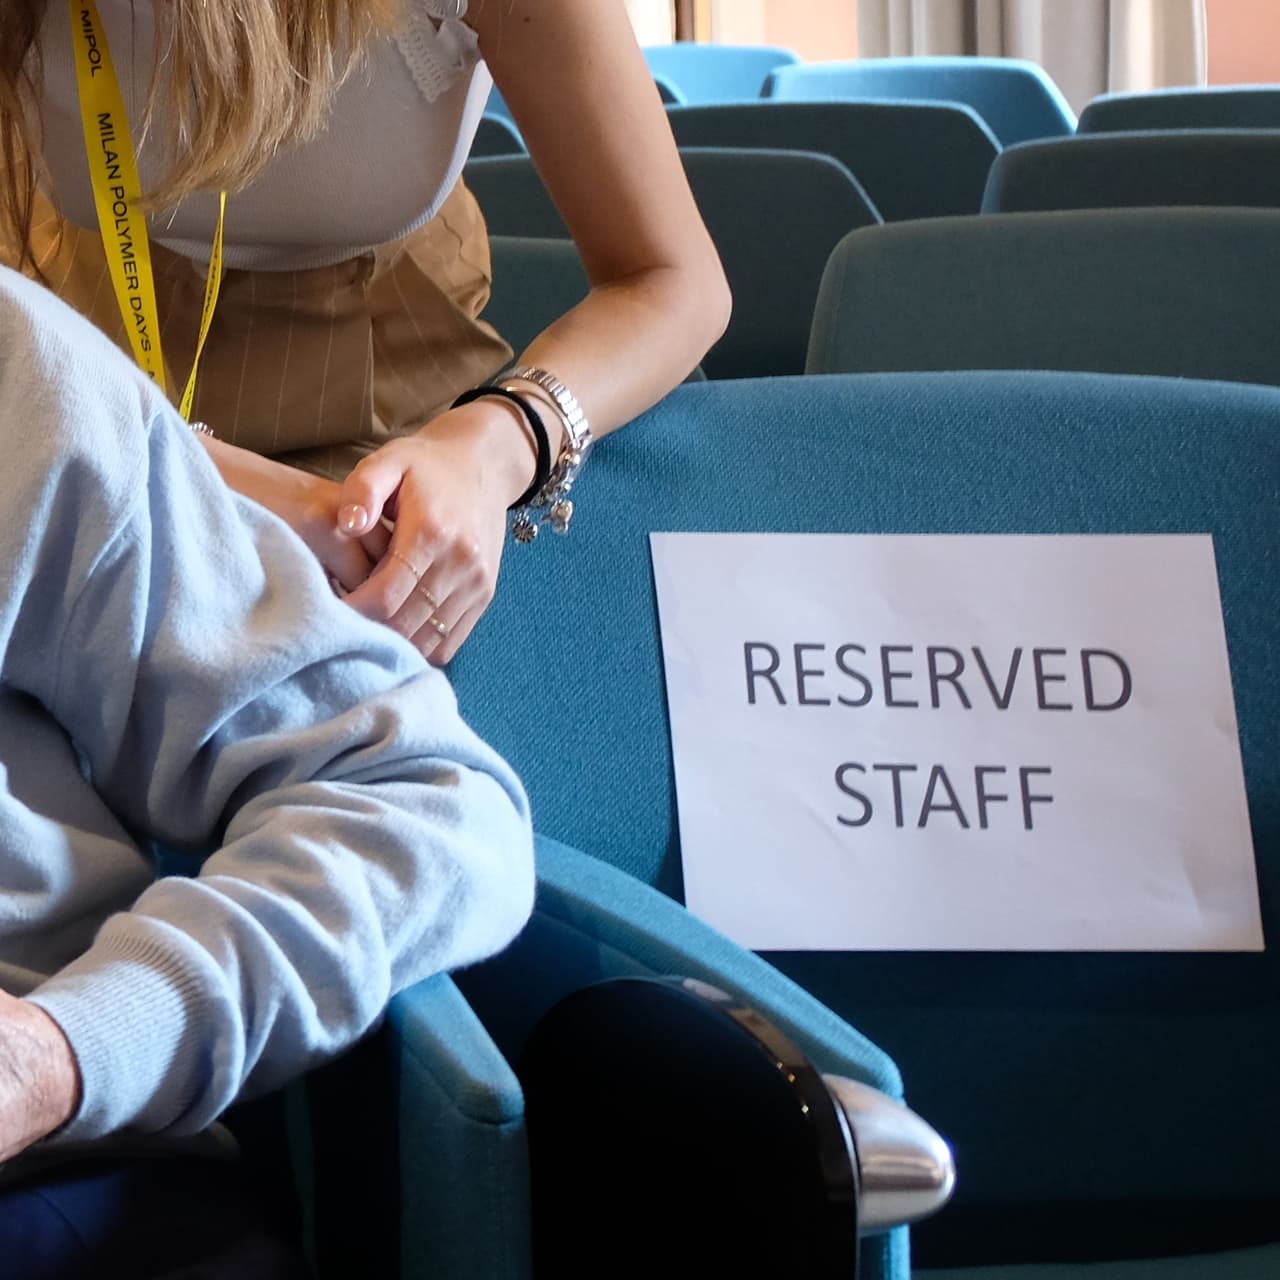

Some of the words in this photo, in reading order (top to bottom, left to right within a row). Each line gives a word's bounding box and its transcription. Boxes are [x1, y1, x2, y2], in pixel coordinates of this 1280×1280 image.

[80, 9, 102, 77] MIPOL
[97, 112, 122, 180] MILAN
[110, 186, 139, 290] POLYMER
[130, 296, 151, 352] DAYS
[742, 641, 1133, 712] RESERVED
[834, 762, 1054, 831] STAFF
